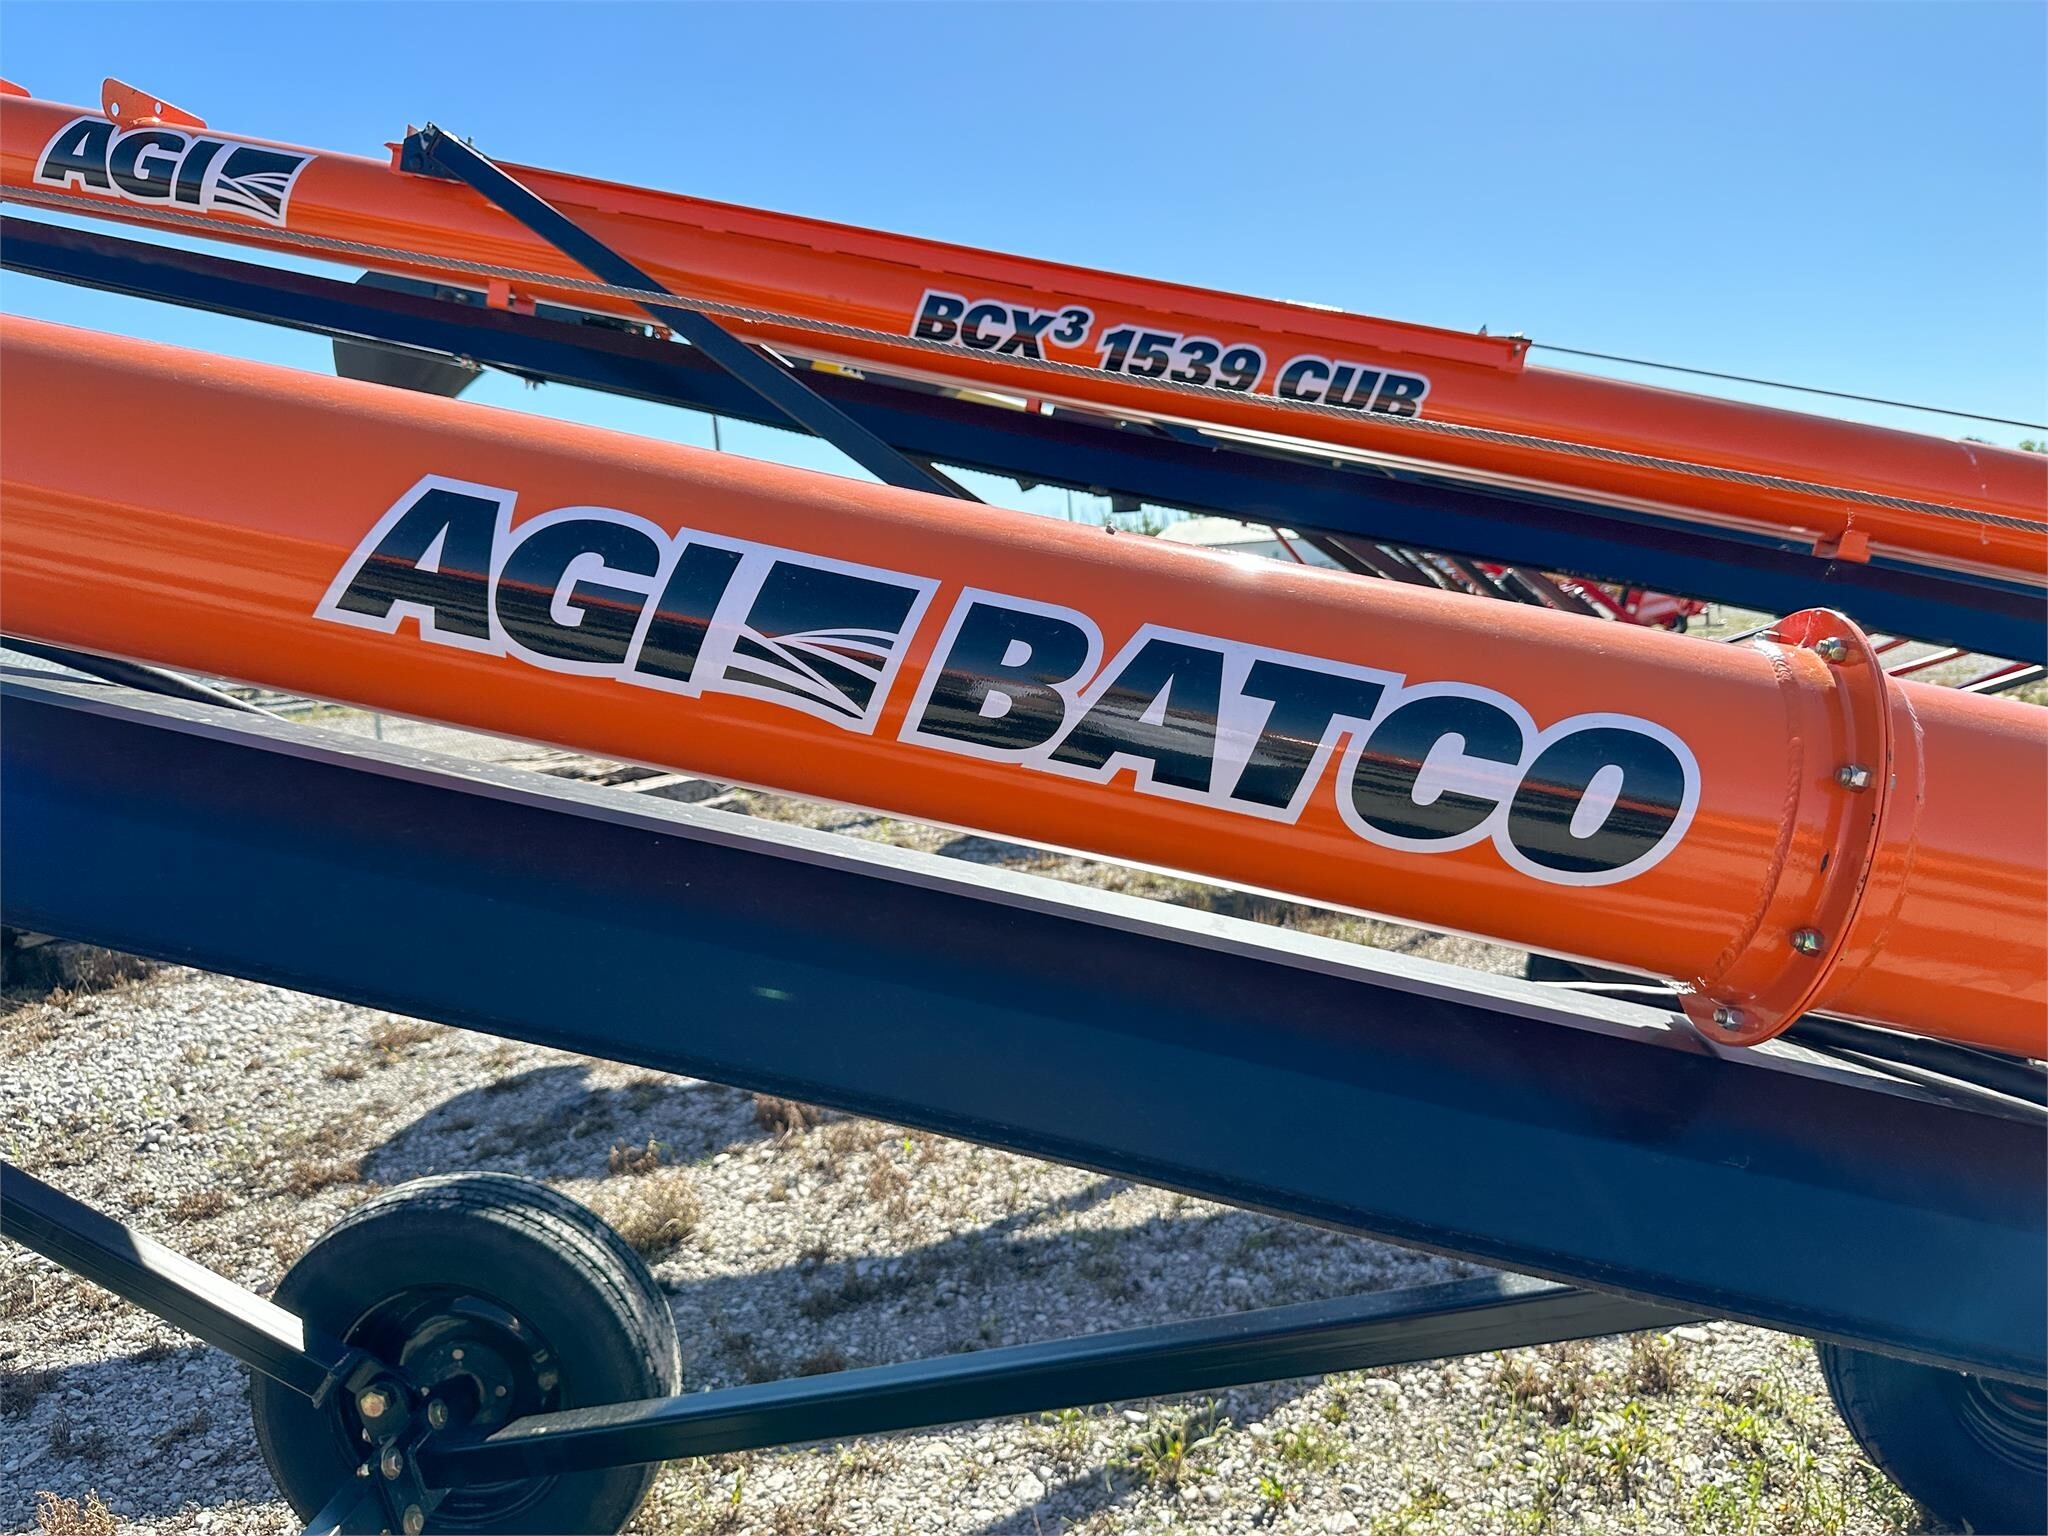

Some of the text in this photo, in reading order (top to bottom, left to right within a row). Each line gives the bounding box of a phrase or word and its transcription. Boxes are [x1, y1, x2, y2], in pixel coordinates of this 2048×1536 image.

[41, 119, 226, 205] AGI
[1101, 329, 1262, 393] 1539
[1278, 359, 1426, 418] CUB
[335, 487, 1686, 874] AGI BATCO
